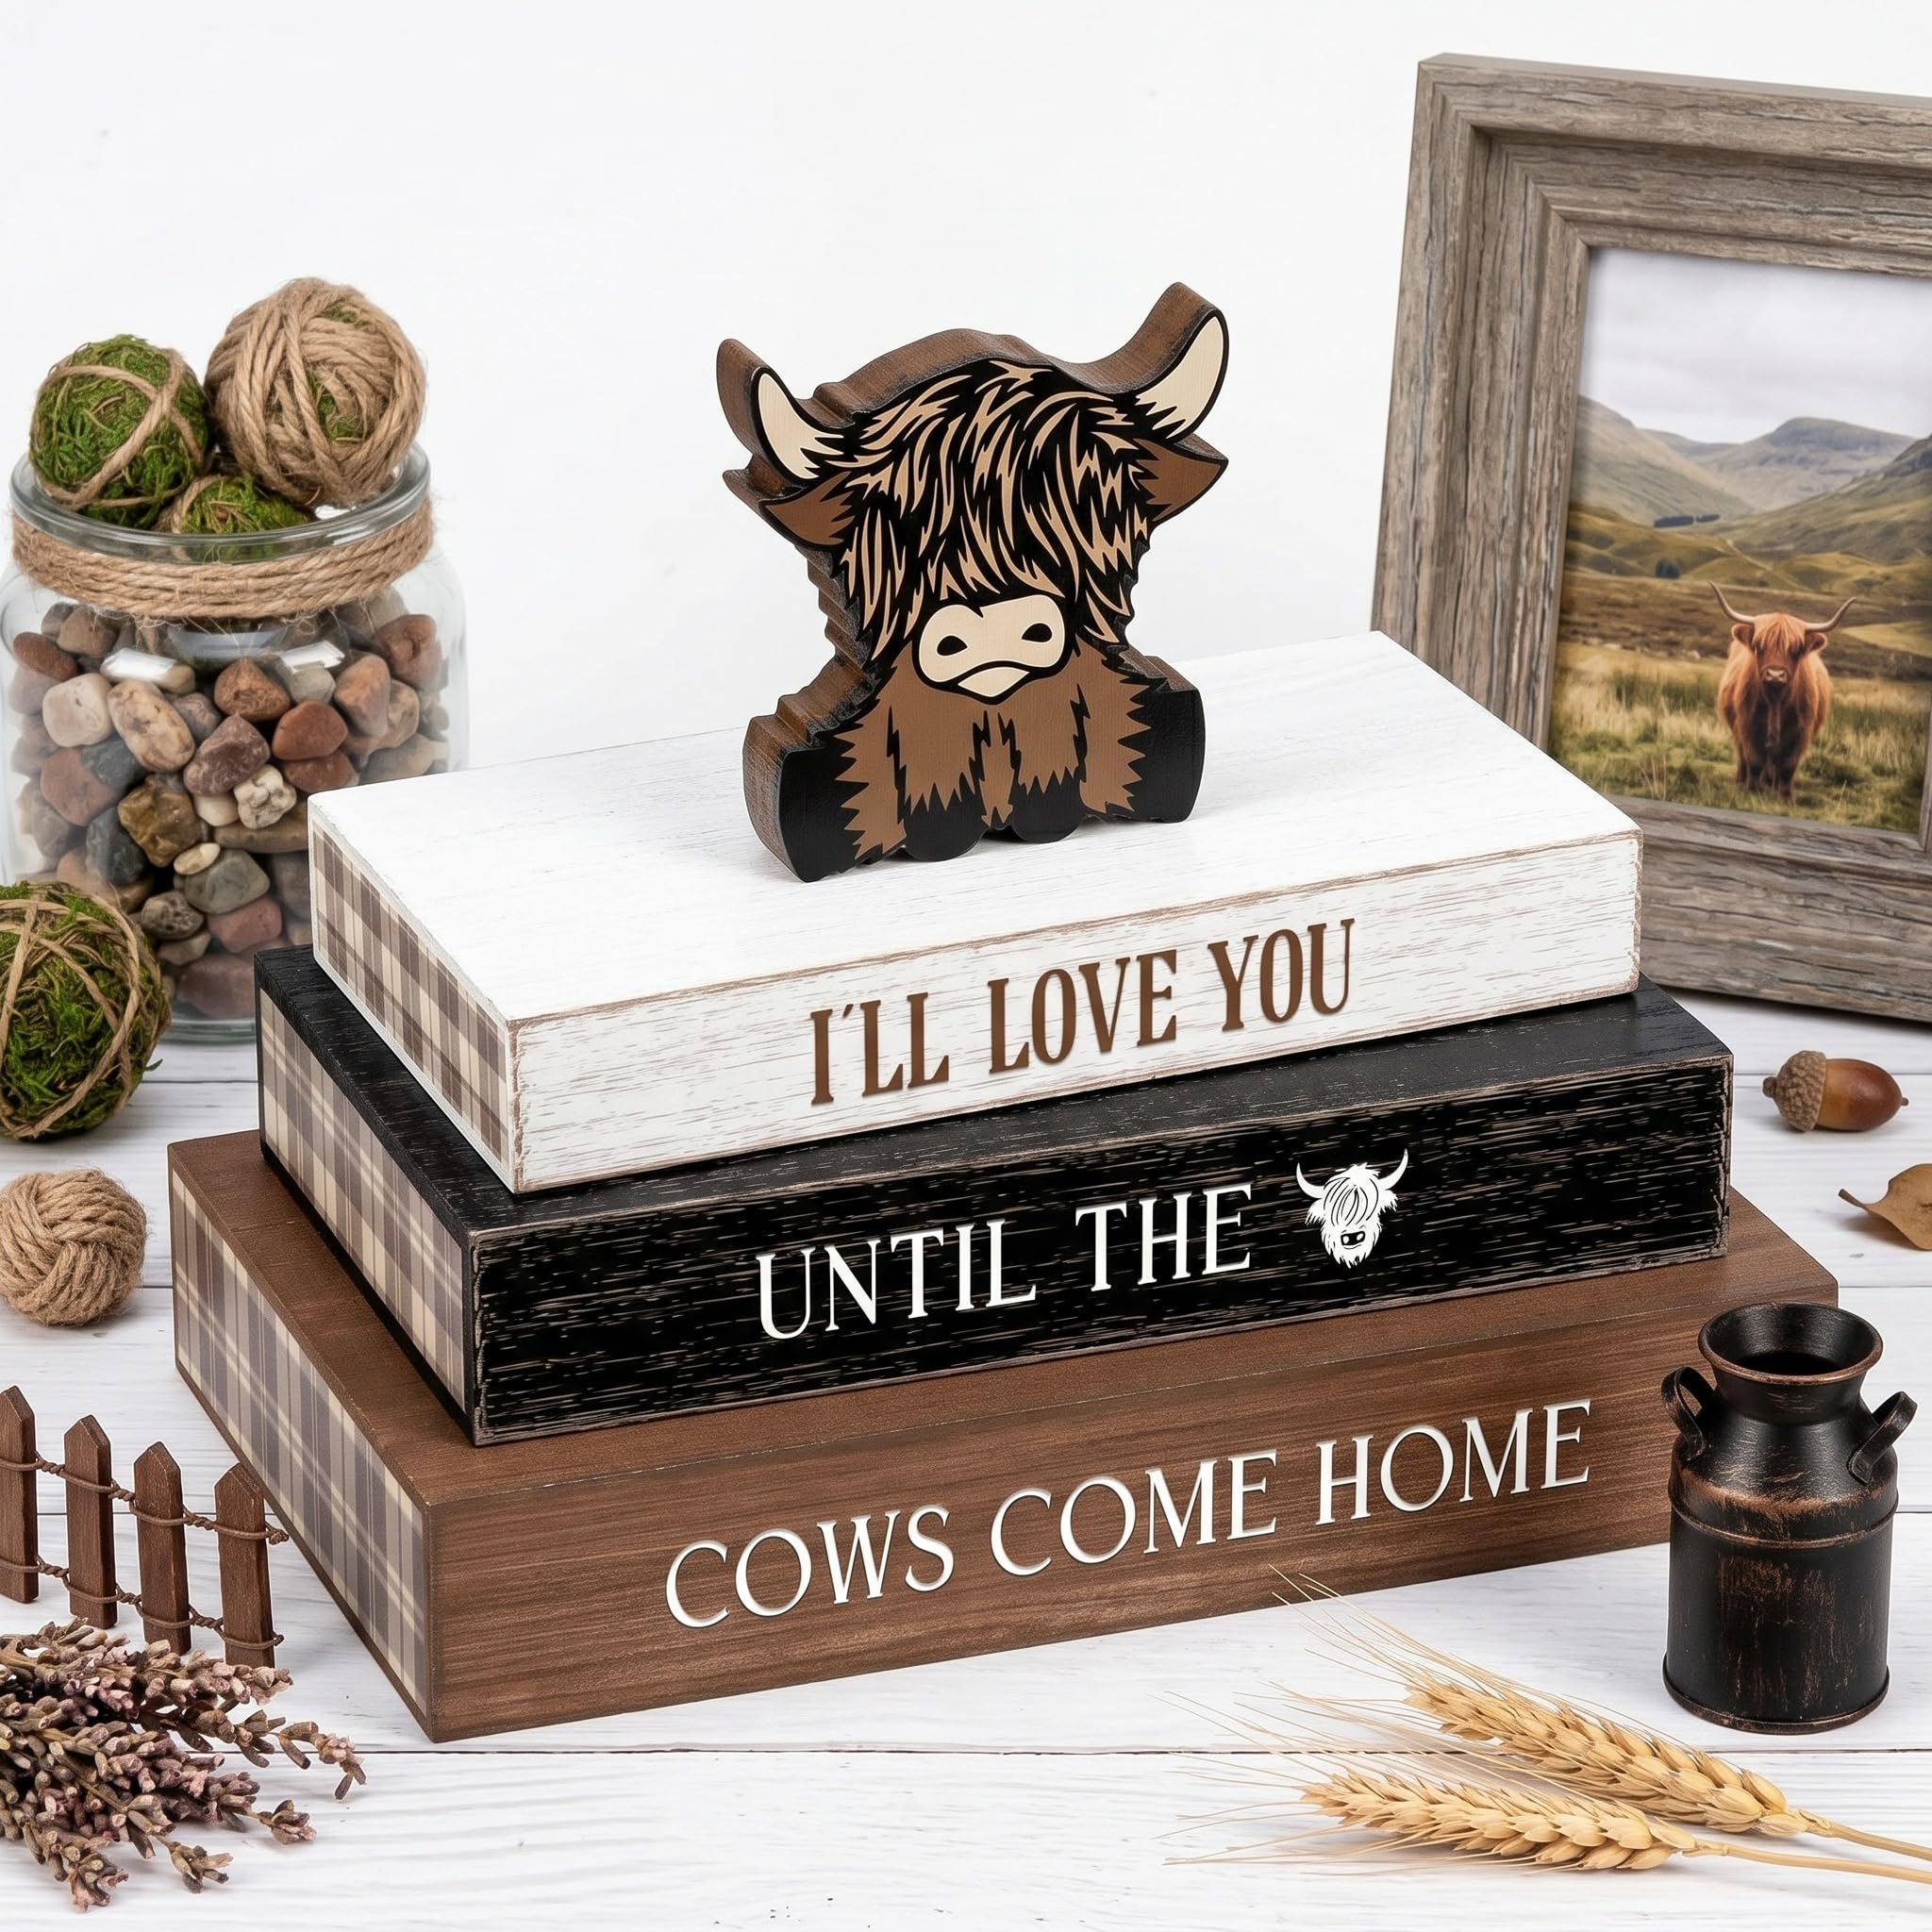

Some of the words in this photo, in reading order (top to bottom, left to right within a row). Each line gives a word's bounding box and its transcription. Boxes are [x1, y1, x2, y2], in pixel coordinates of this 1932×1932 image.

[808, 991, 950, 1106] I'LL
[986, 948, 1178, 1074] LOVE
[1207, 917, 1356, 1031] YOU
[756, 1219, 1037, 1340] UNTIL
[1074, 1183, 1253, 1291] THE
[664, 1504, 955, 1629] COWS
[990, 1448, 1277, 1576] COME
[1314, 1398, 1592, 1525] HOME
